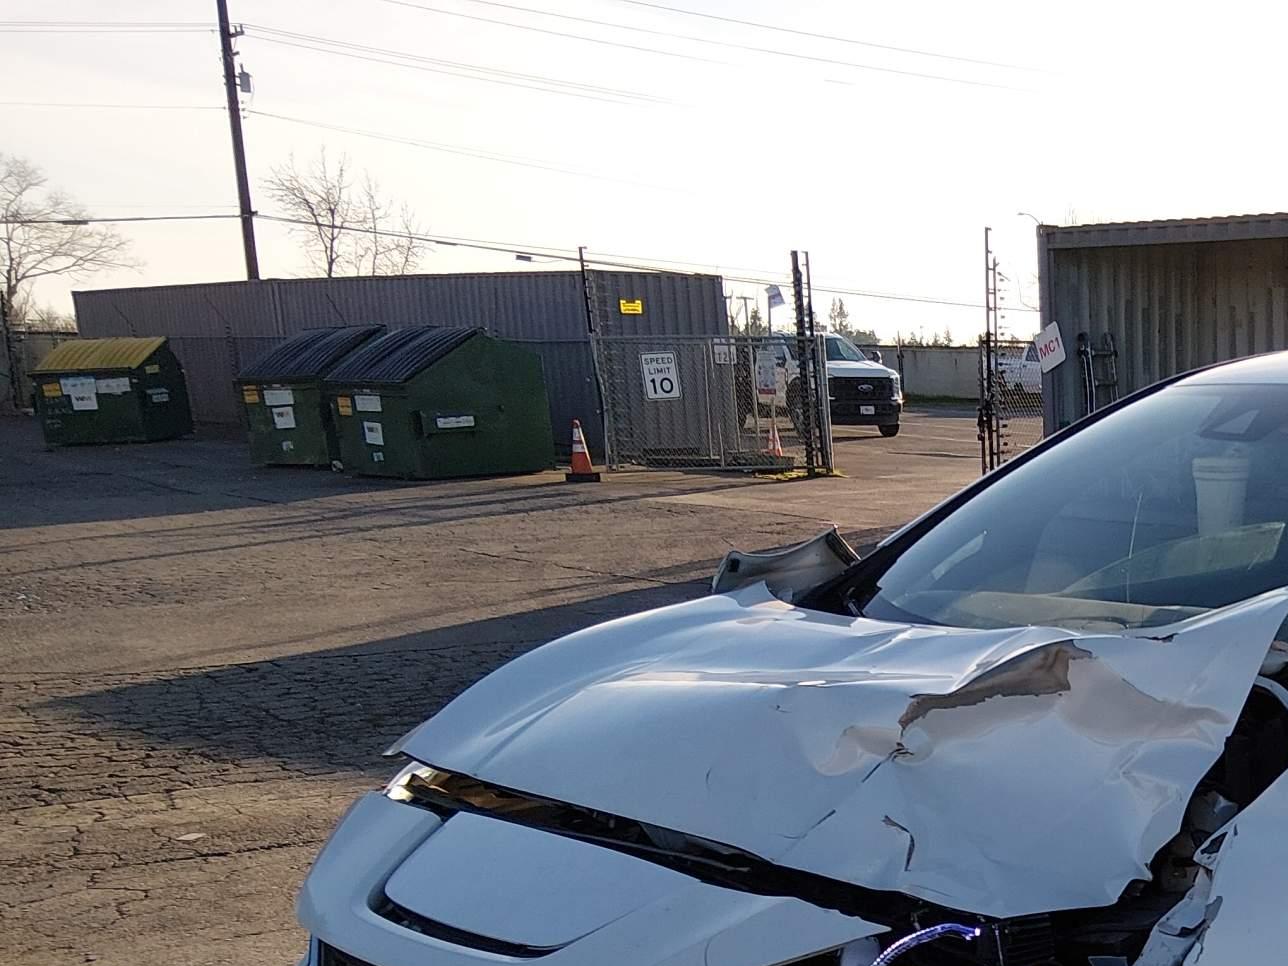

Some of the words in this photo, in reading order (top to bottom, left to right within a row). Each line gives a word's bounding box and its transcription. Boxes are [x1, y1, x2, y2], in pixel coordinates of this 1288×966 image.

[1039, 336, 1061, 360] MC1
[643, 356, 673, 366] SPEED
[648, 367, 671, 375] LIMIT
[649, 377, 674, 395] 10
